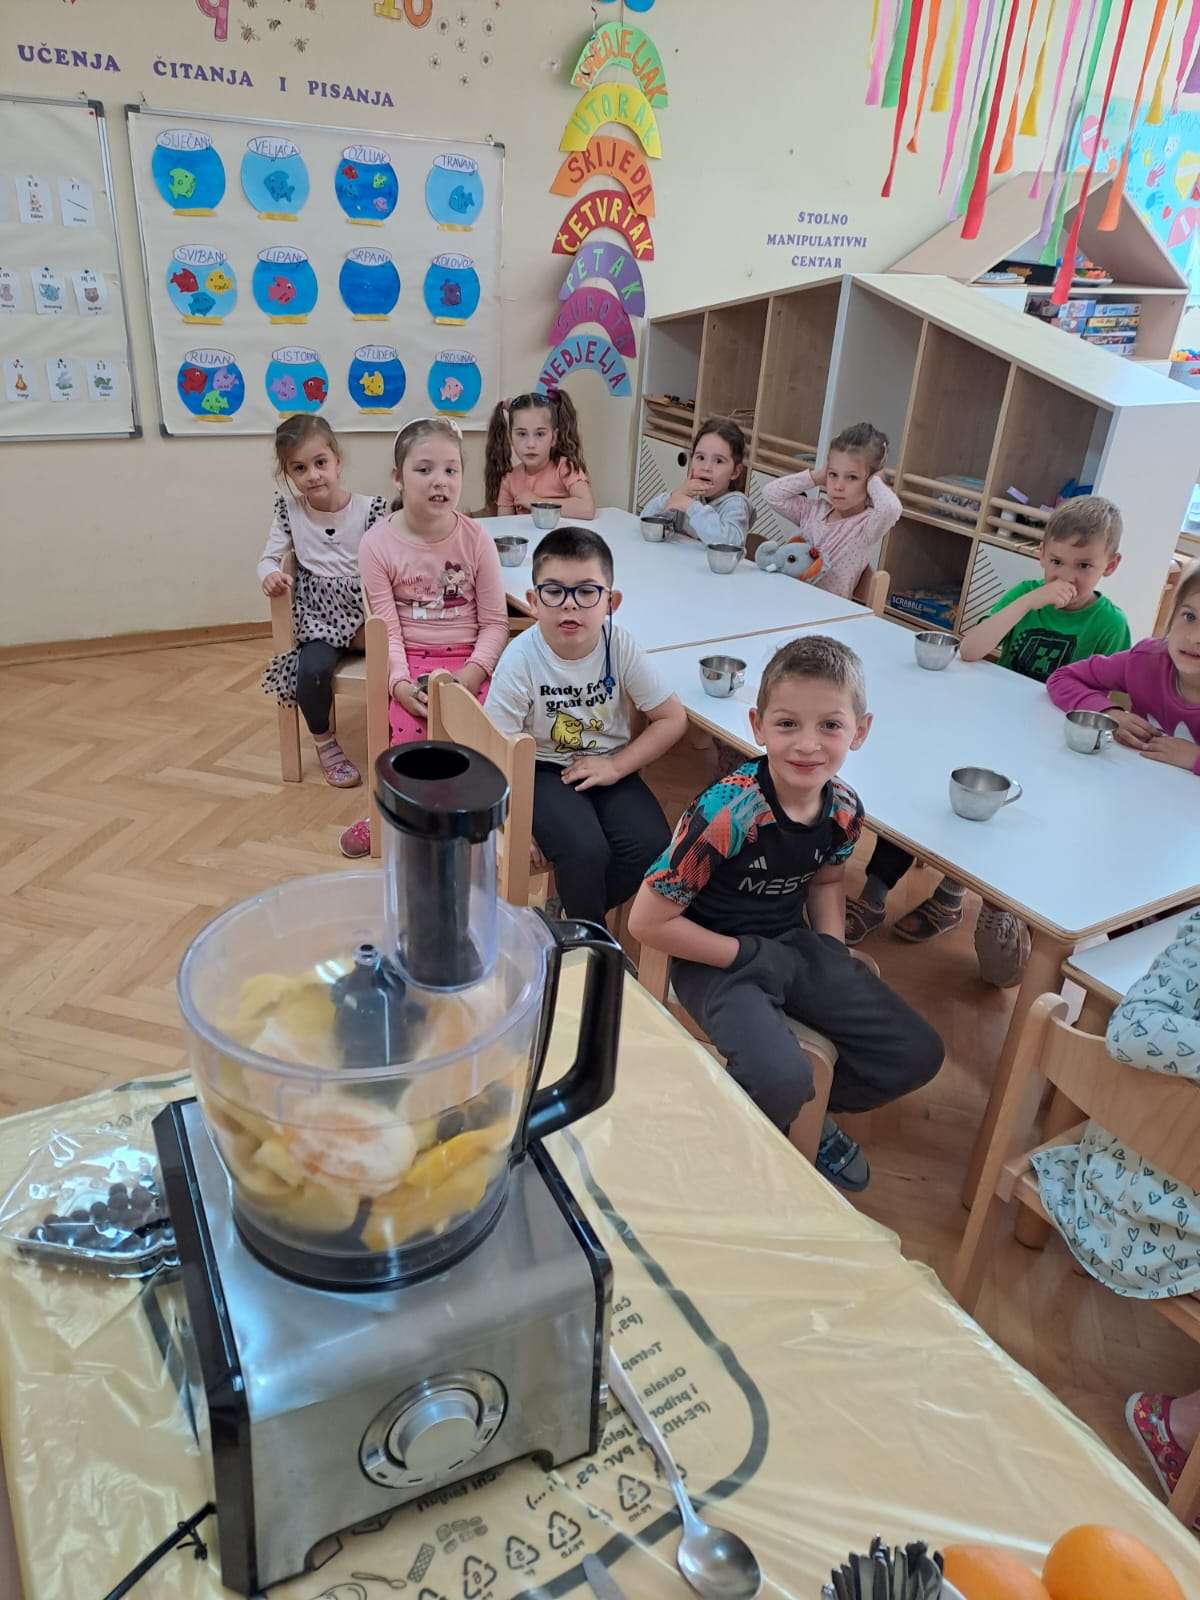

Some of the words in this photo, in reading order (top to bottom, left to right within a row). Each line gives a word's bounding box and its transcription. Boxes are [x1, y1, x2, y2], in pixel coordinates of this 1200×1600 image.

[17, 42, 120, 72] UČENJA
[153, 56, 253, 87] ČITANJA
[279, 76, 287, 92] I
[308, 80, 394, 107] PISANJA
[573, 93, 657, 145] UTORAK
[568, 142, 652, 207] SRIJEDA
[557, 198, 652, 259] ČETVRTAK
[797, 211, 848, 225] STOLNO
[767, 234, 867, 248] MANIPULATIVNI
[566, 248, 642, 300] PETAK
[791, 255, 842, 268] CENTAR
[191, 352, 231, 365] RUJAN
[540, 341, 626, 388] NEDJELJA
[540, 685, 582, 697] Ready
[546, 697, 581, 712] great
